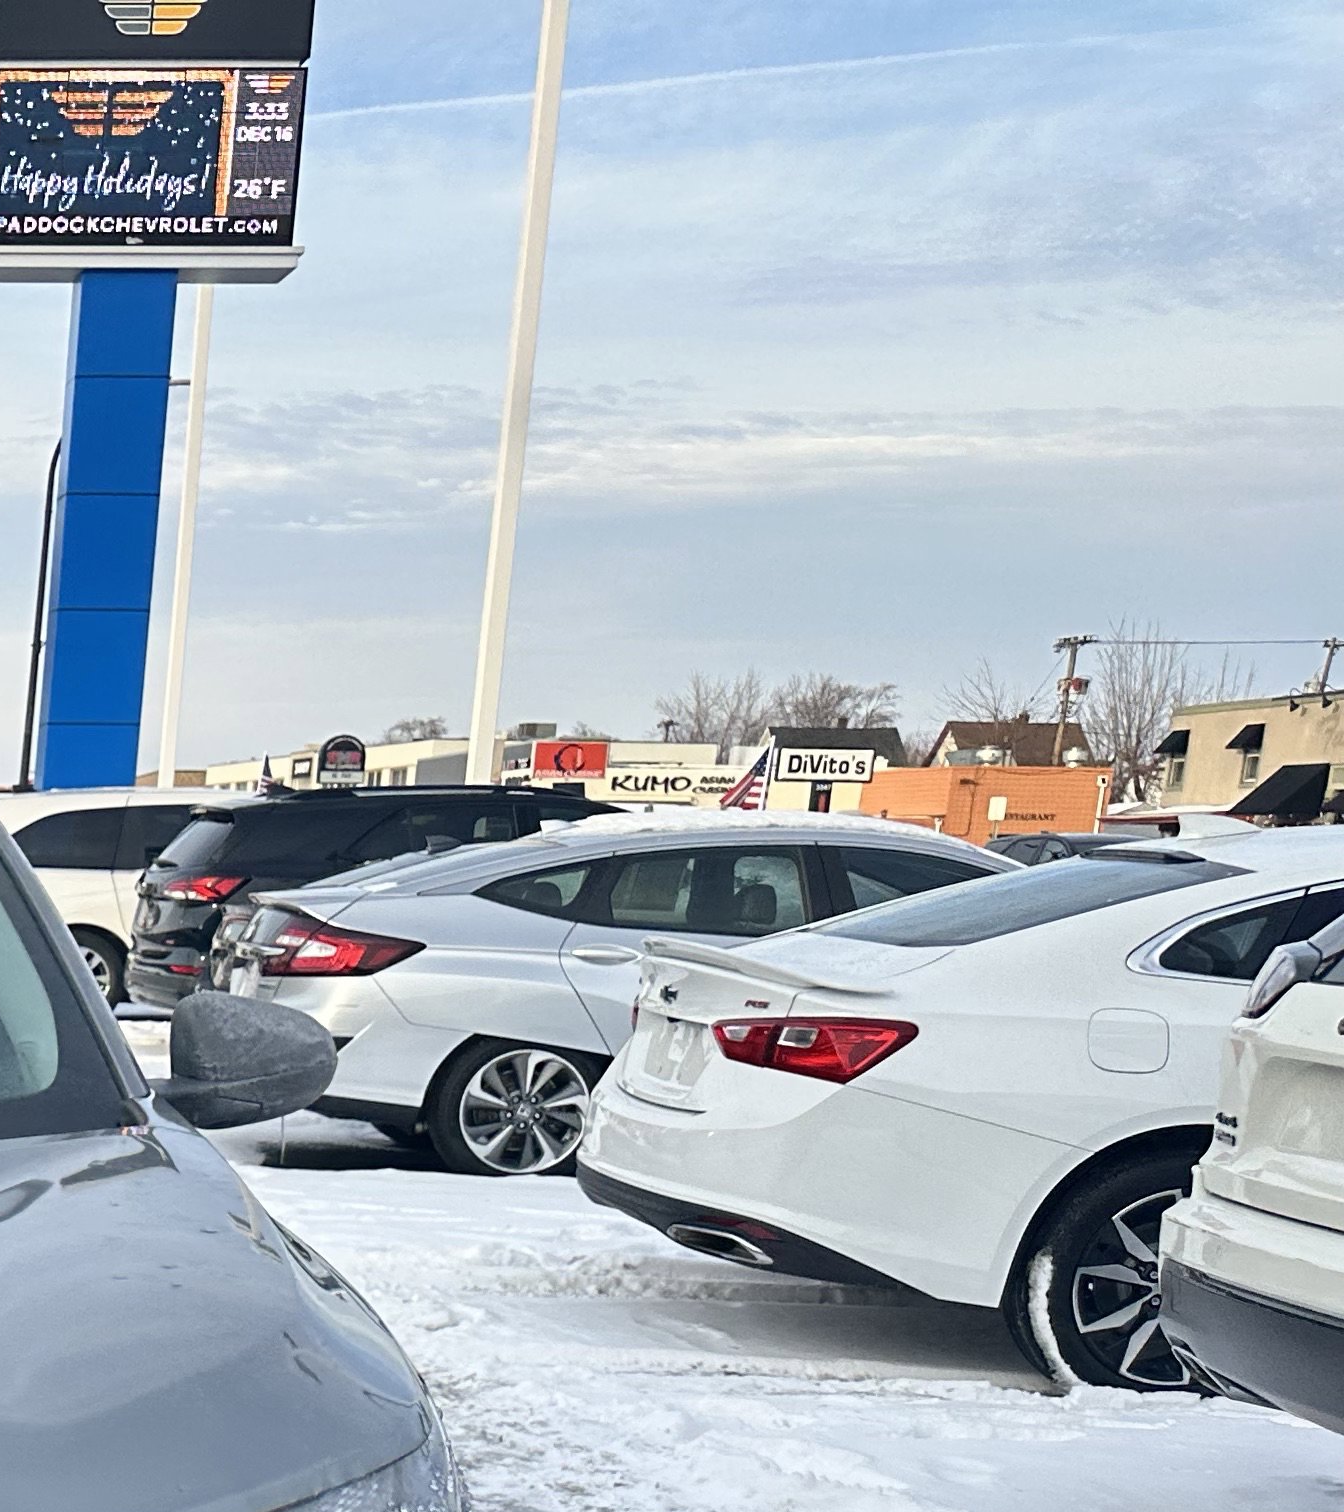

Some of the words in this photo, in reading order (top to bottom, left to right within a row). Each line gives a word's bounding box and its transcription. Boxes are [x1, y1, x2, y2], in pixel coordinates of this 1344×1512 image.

[236, 126, 272, 142] DEC
[274, 126, 293, 142] 16
[0, 156, 79, 212] Happy
[83, 153, 211, 212] Holidays!
[787, 754, 866, 775] DiVito's
[611, 775, 692, 794] KUMO
[1005, 813, 1056, 821] ESTAURANT
